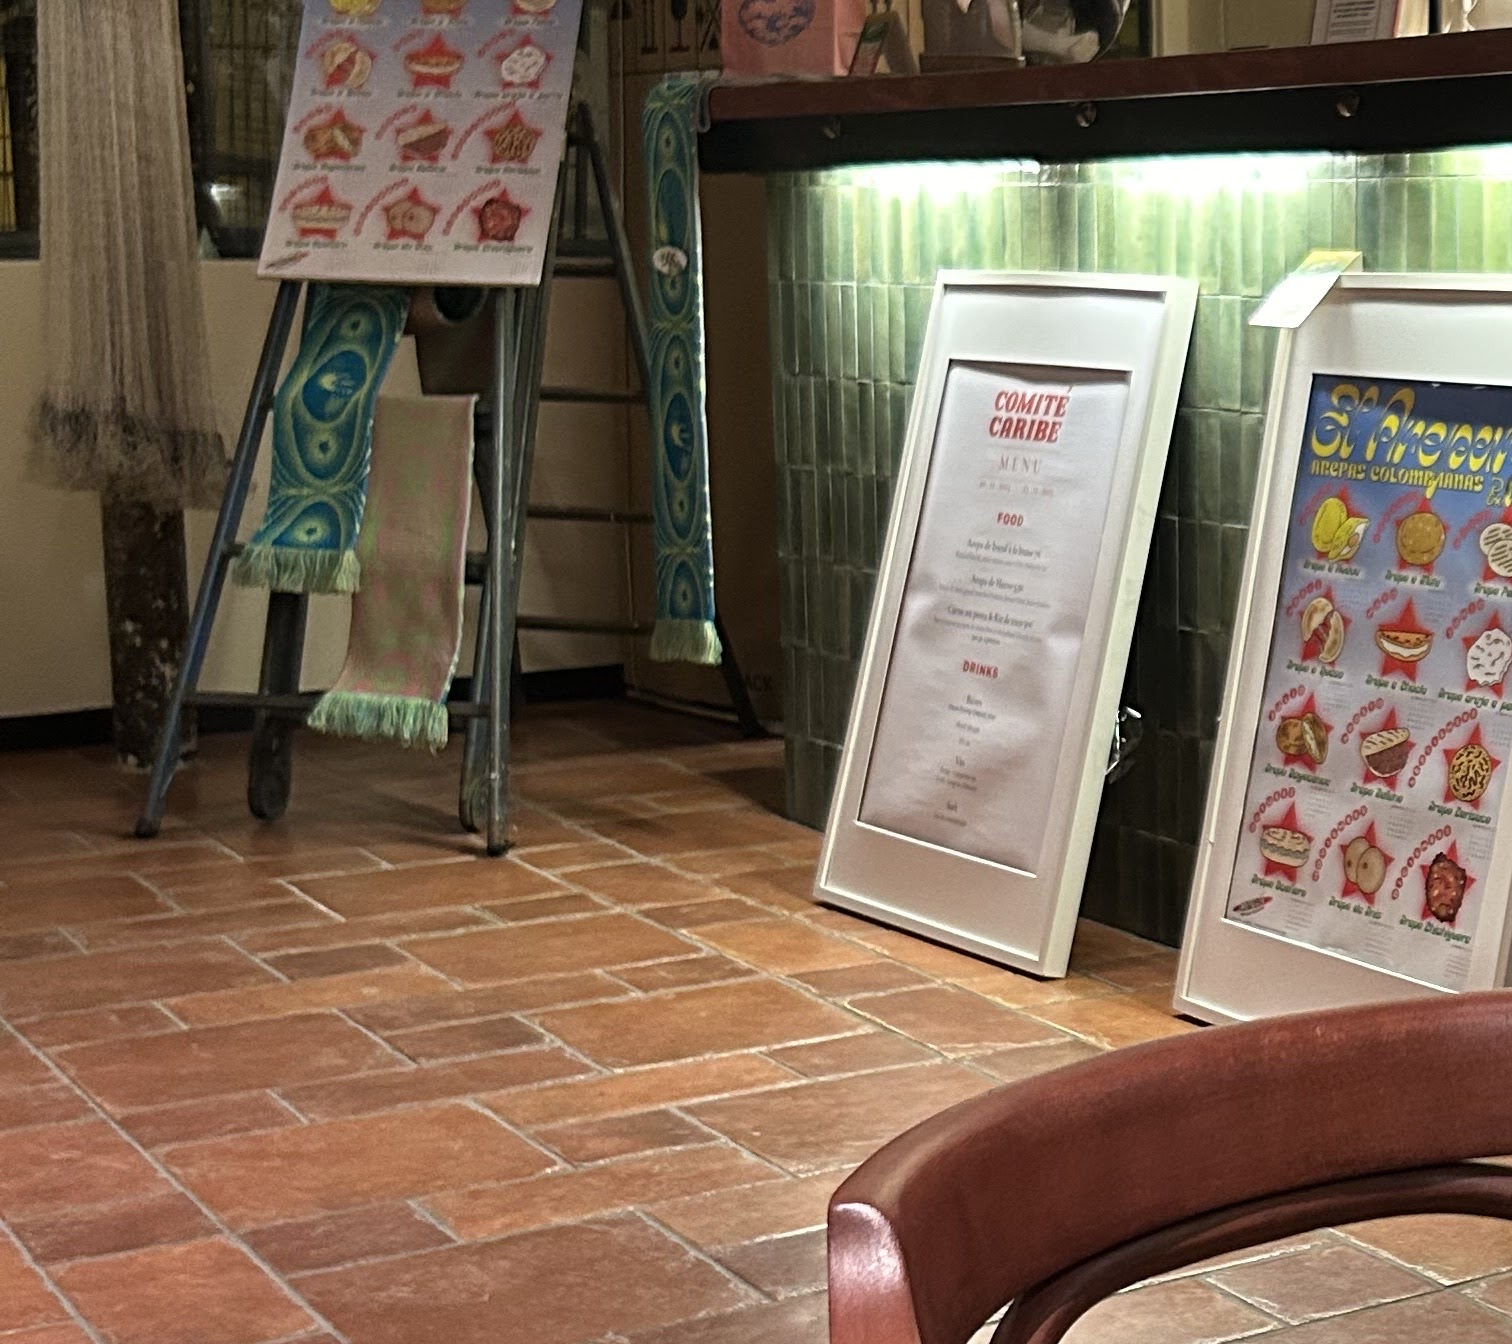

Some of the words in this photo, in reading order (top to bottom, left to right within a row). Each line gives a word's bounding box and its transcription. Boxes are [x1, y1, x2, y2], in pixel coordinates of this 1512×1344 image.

[994, 386, 1073, 418] COMITÉ
[989, 416, 1062, 443] CARIBE
[1311, 383, 1380, 459] El
[999, 455, 1041, 474] MENU
[1311, 460, 1366, 480] AREPAS
[1369, 466, 1484, 498] COLOMBIANAS
[996, 512, 1024, 527] FOOD
[962, 660, 999, 679] DRINKS
